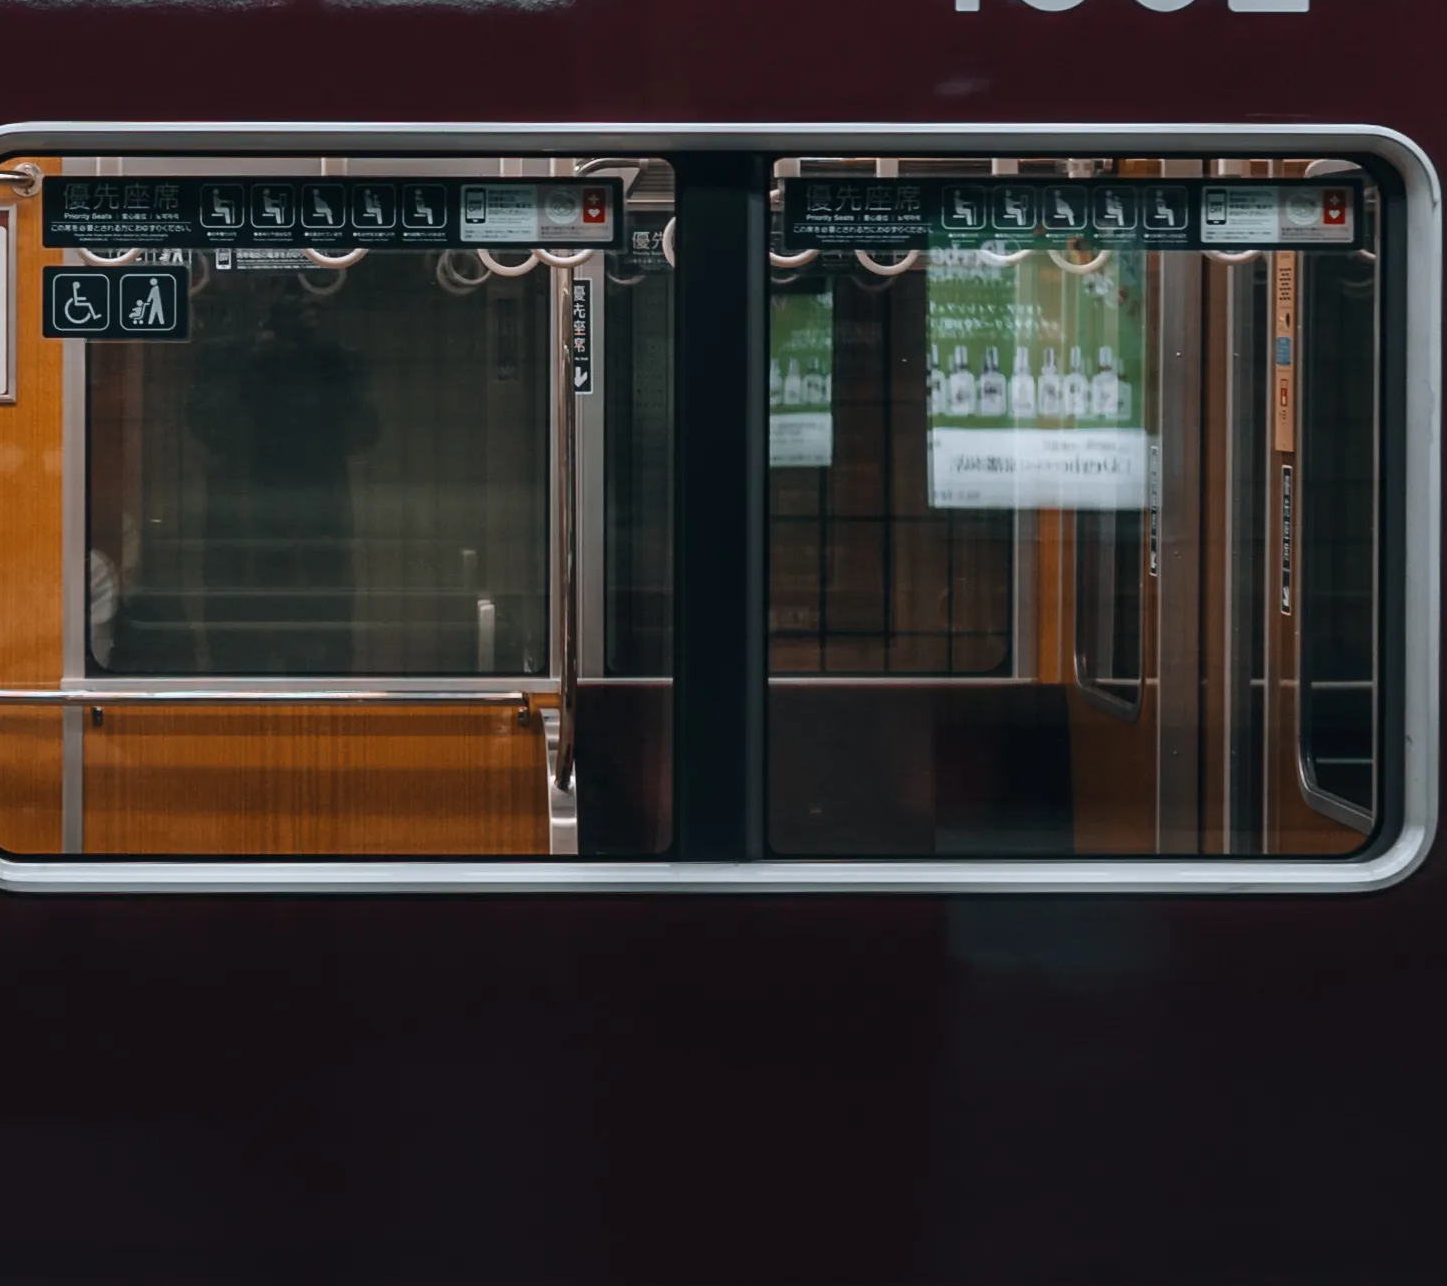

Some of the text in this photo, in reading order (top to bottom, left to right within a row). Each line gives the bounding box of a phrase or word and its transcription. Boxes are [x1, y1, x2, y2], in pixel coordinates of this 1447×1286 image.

[63, 181, 180, 210] 優先座席
[805, 184, 921, 212] 優先座席
[64, 213, 90, 221] Priority
